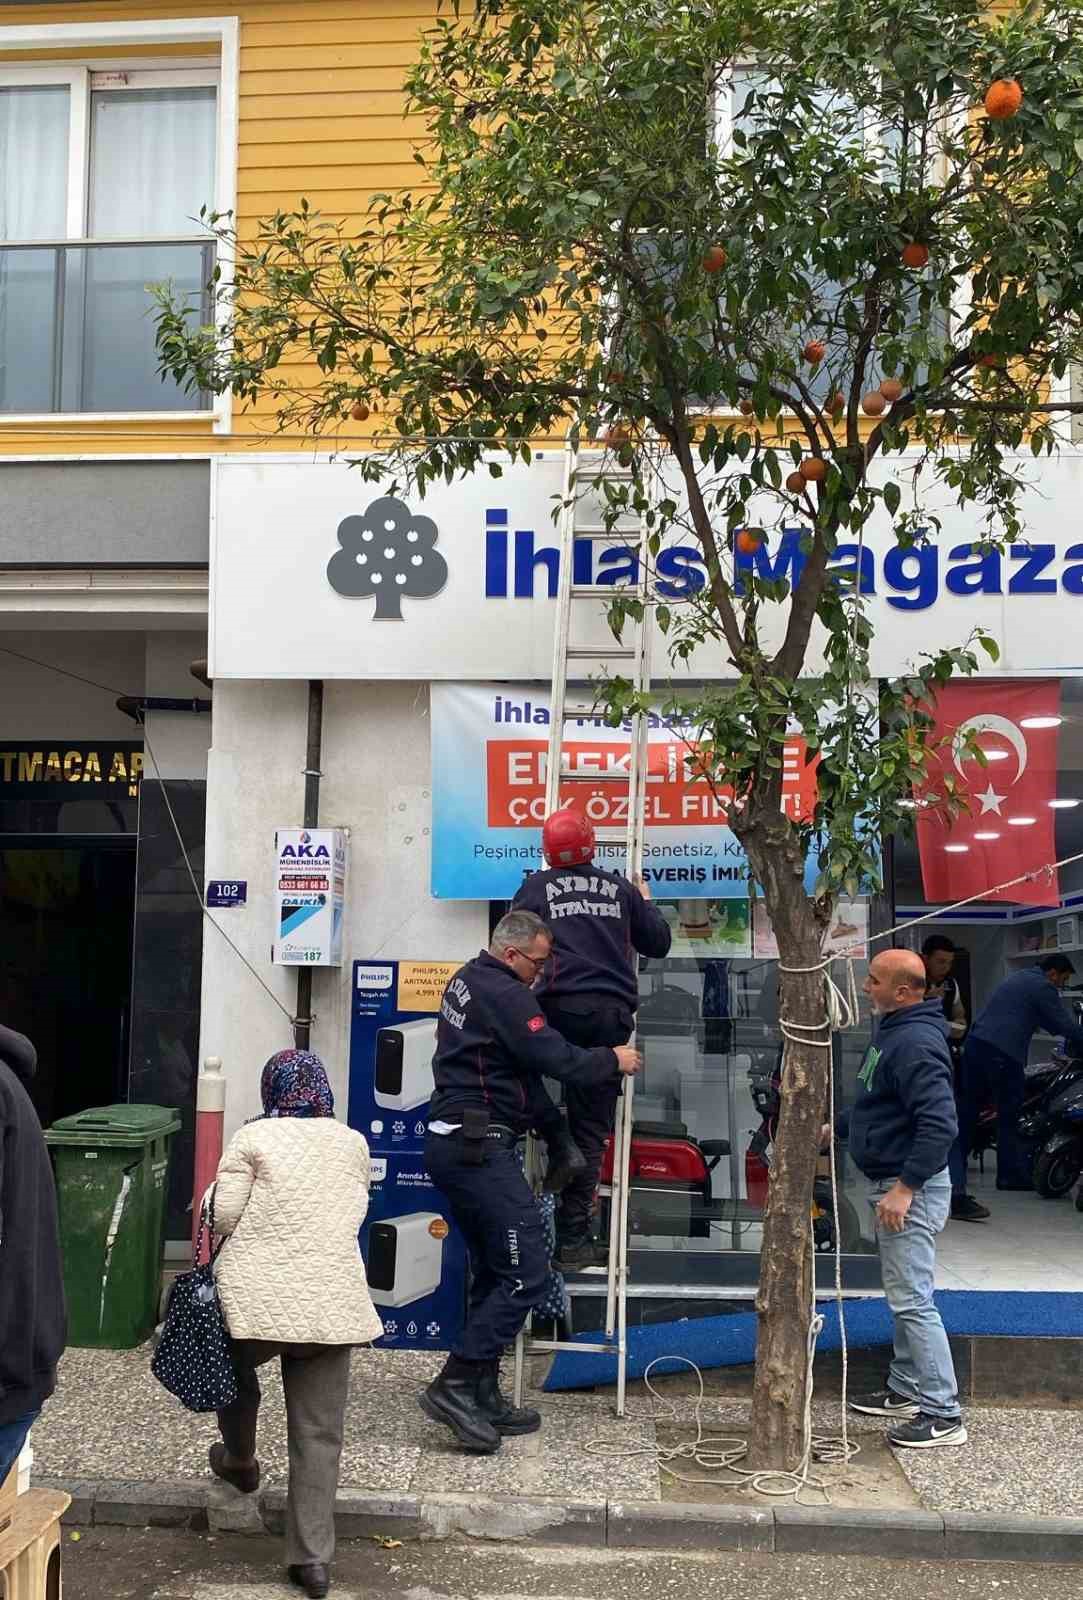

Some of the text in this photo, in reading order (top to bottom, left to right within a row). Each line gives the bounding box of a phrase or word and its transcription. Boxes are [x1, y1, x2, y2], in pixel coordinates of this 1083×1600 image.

[494, 695, 550, 725] İhla
[281, 845, 329, 857] AKA
[217, 885, 238, 897] 102
[545, 876, 619, 902] AYDIN
[361, 974, 390, 982] PHILIPS
